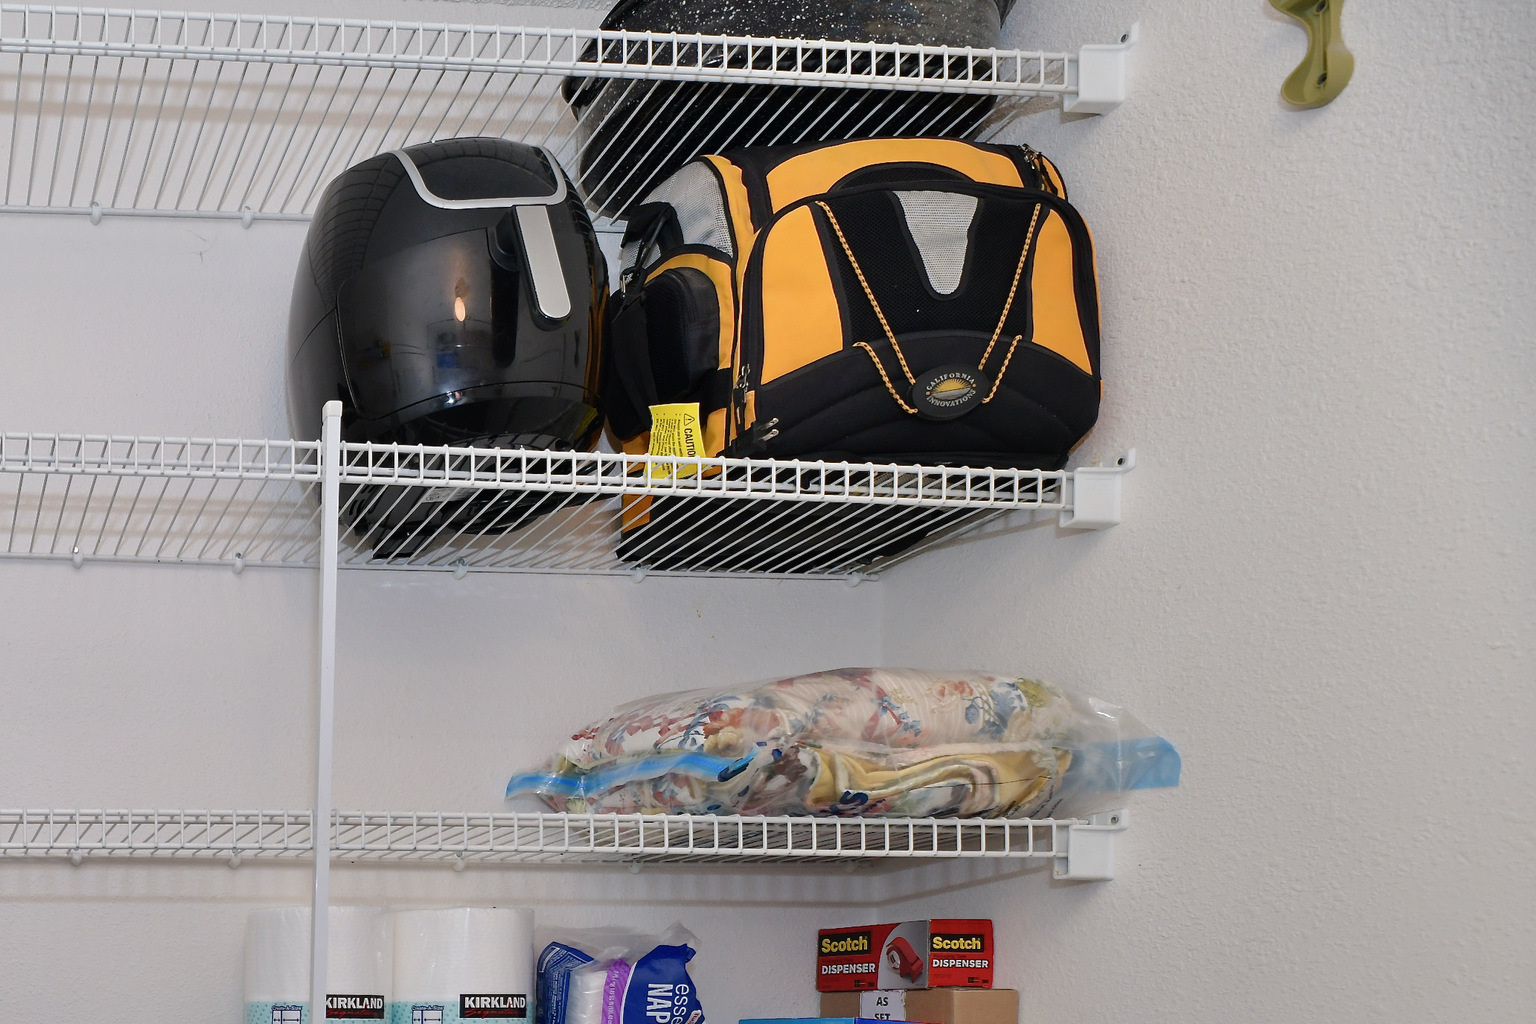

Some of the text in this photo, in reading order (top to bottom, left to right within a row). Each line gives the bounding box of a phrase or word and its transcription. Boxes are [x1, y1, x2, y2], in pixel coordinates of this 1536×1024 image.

[926, 372, 975, 391] CALIFORNIA
[926, 389, 976, 407] INNOVATIONS
[684, 427, 696, 457] CAUTIO
[821, 935, 868, 953] Scotch
[932, 936, 981, 950] Scotch
[821, 963, 876, 975] DISPENSER
[932, 959, 989, 968] DISPENSER
[325, 997, 383, 1009] KIRKLAND
[464, 996, 526, 1008] KIRKLAND
[876, 997, 889, 1006] AS
